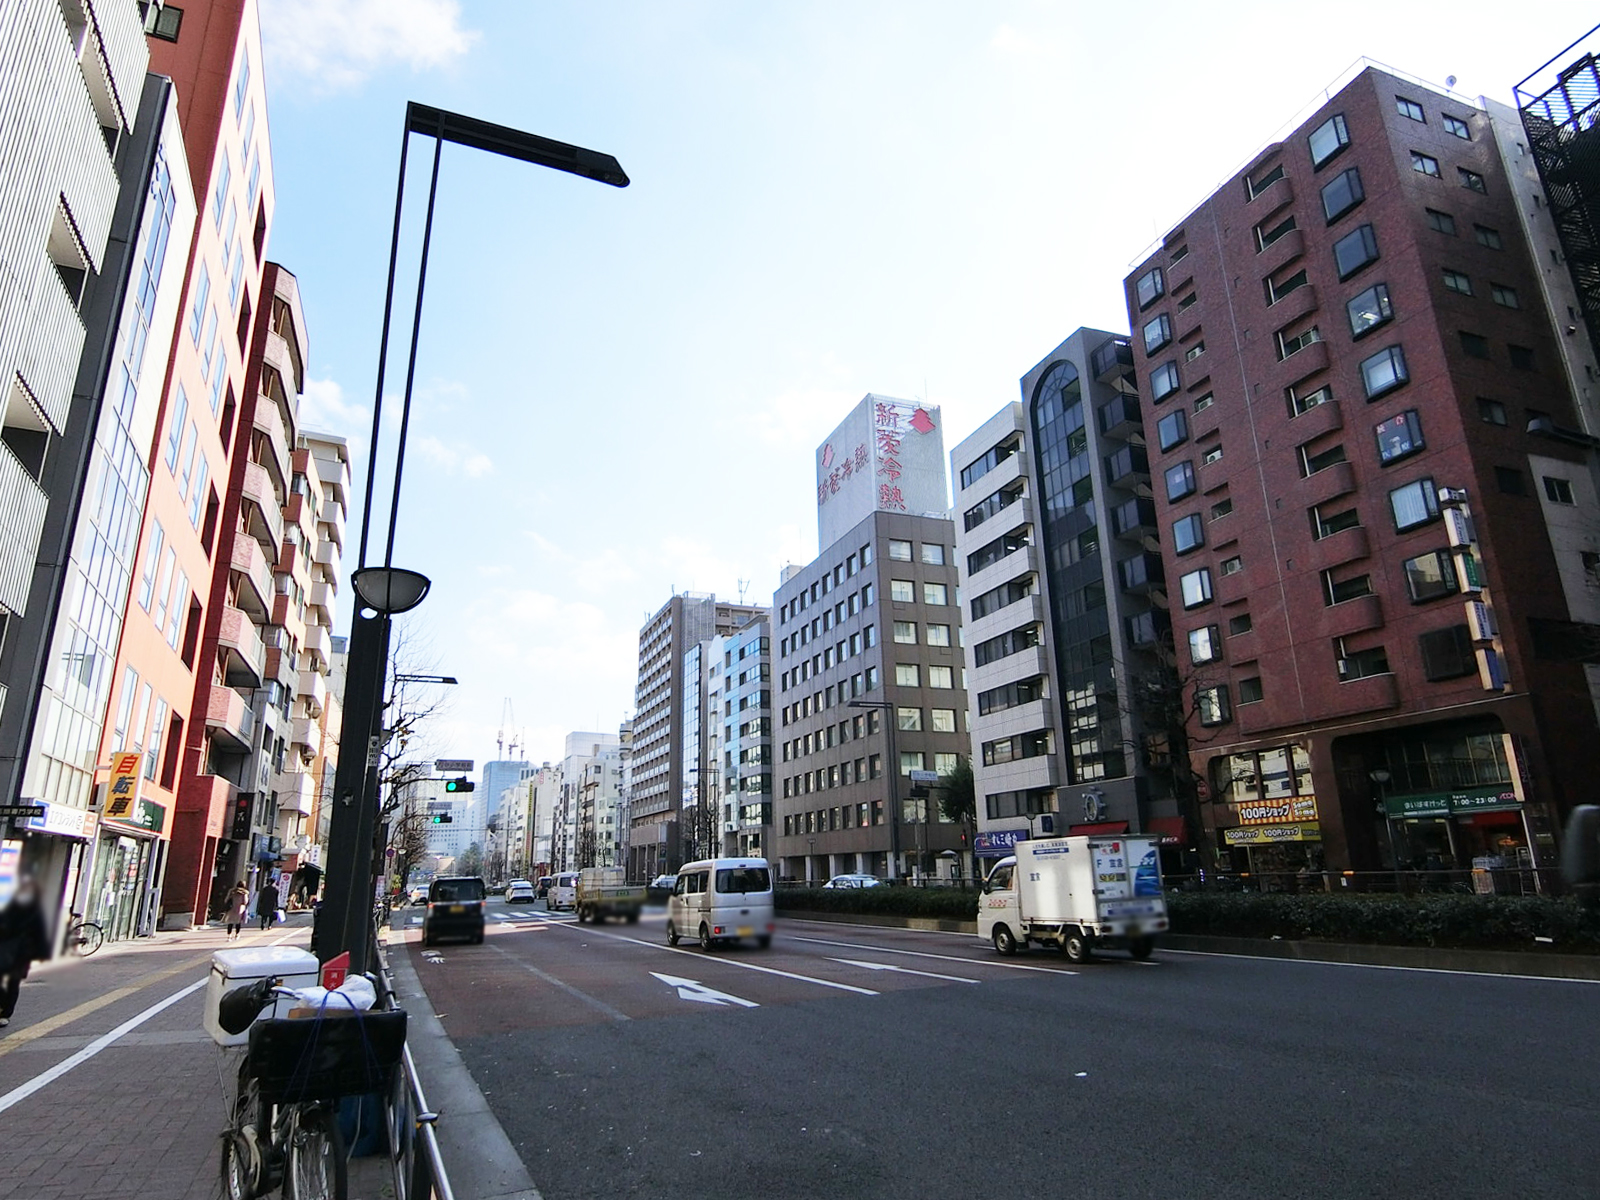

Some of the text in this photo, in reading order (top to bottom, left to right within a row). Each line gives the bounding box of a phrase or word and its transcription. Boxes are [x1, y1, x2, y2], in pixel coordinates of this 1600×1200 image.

[875, 402, 906, 511] 新菱冷熱
[107, 755, 138, 816] 自転車
[1240, 805, 1290, 820] 100円ショップ
[1226, 829, 1260, 840] 100円ショップ
[1263, 826, 1300, 837] 100円ショップ
